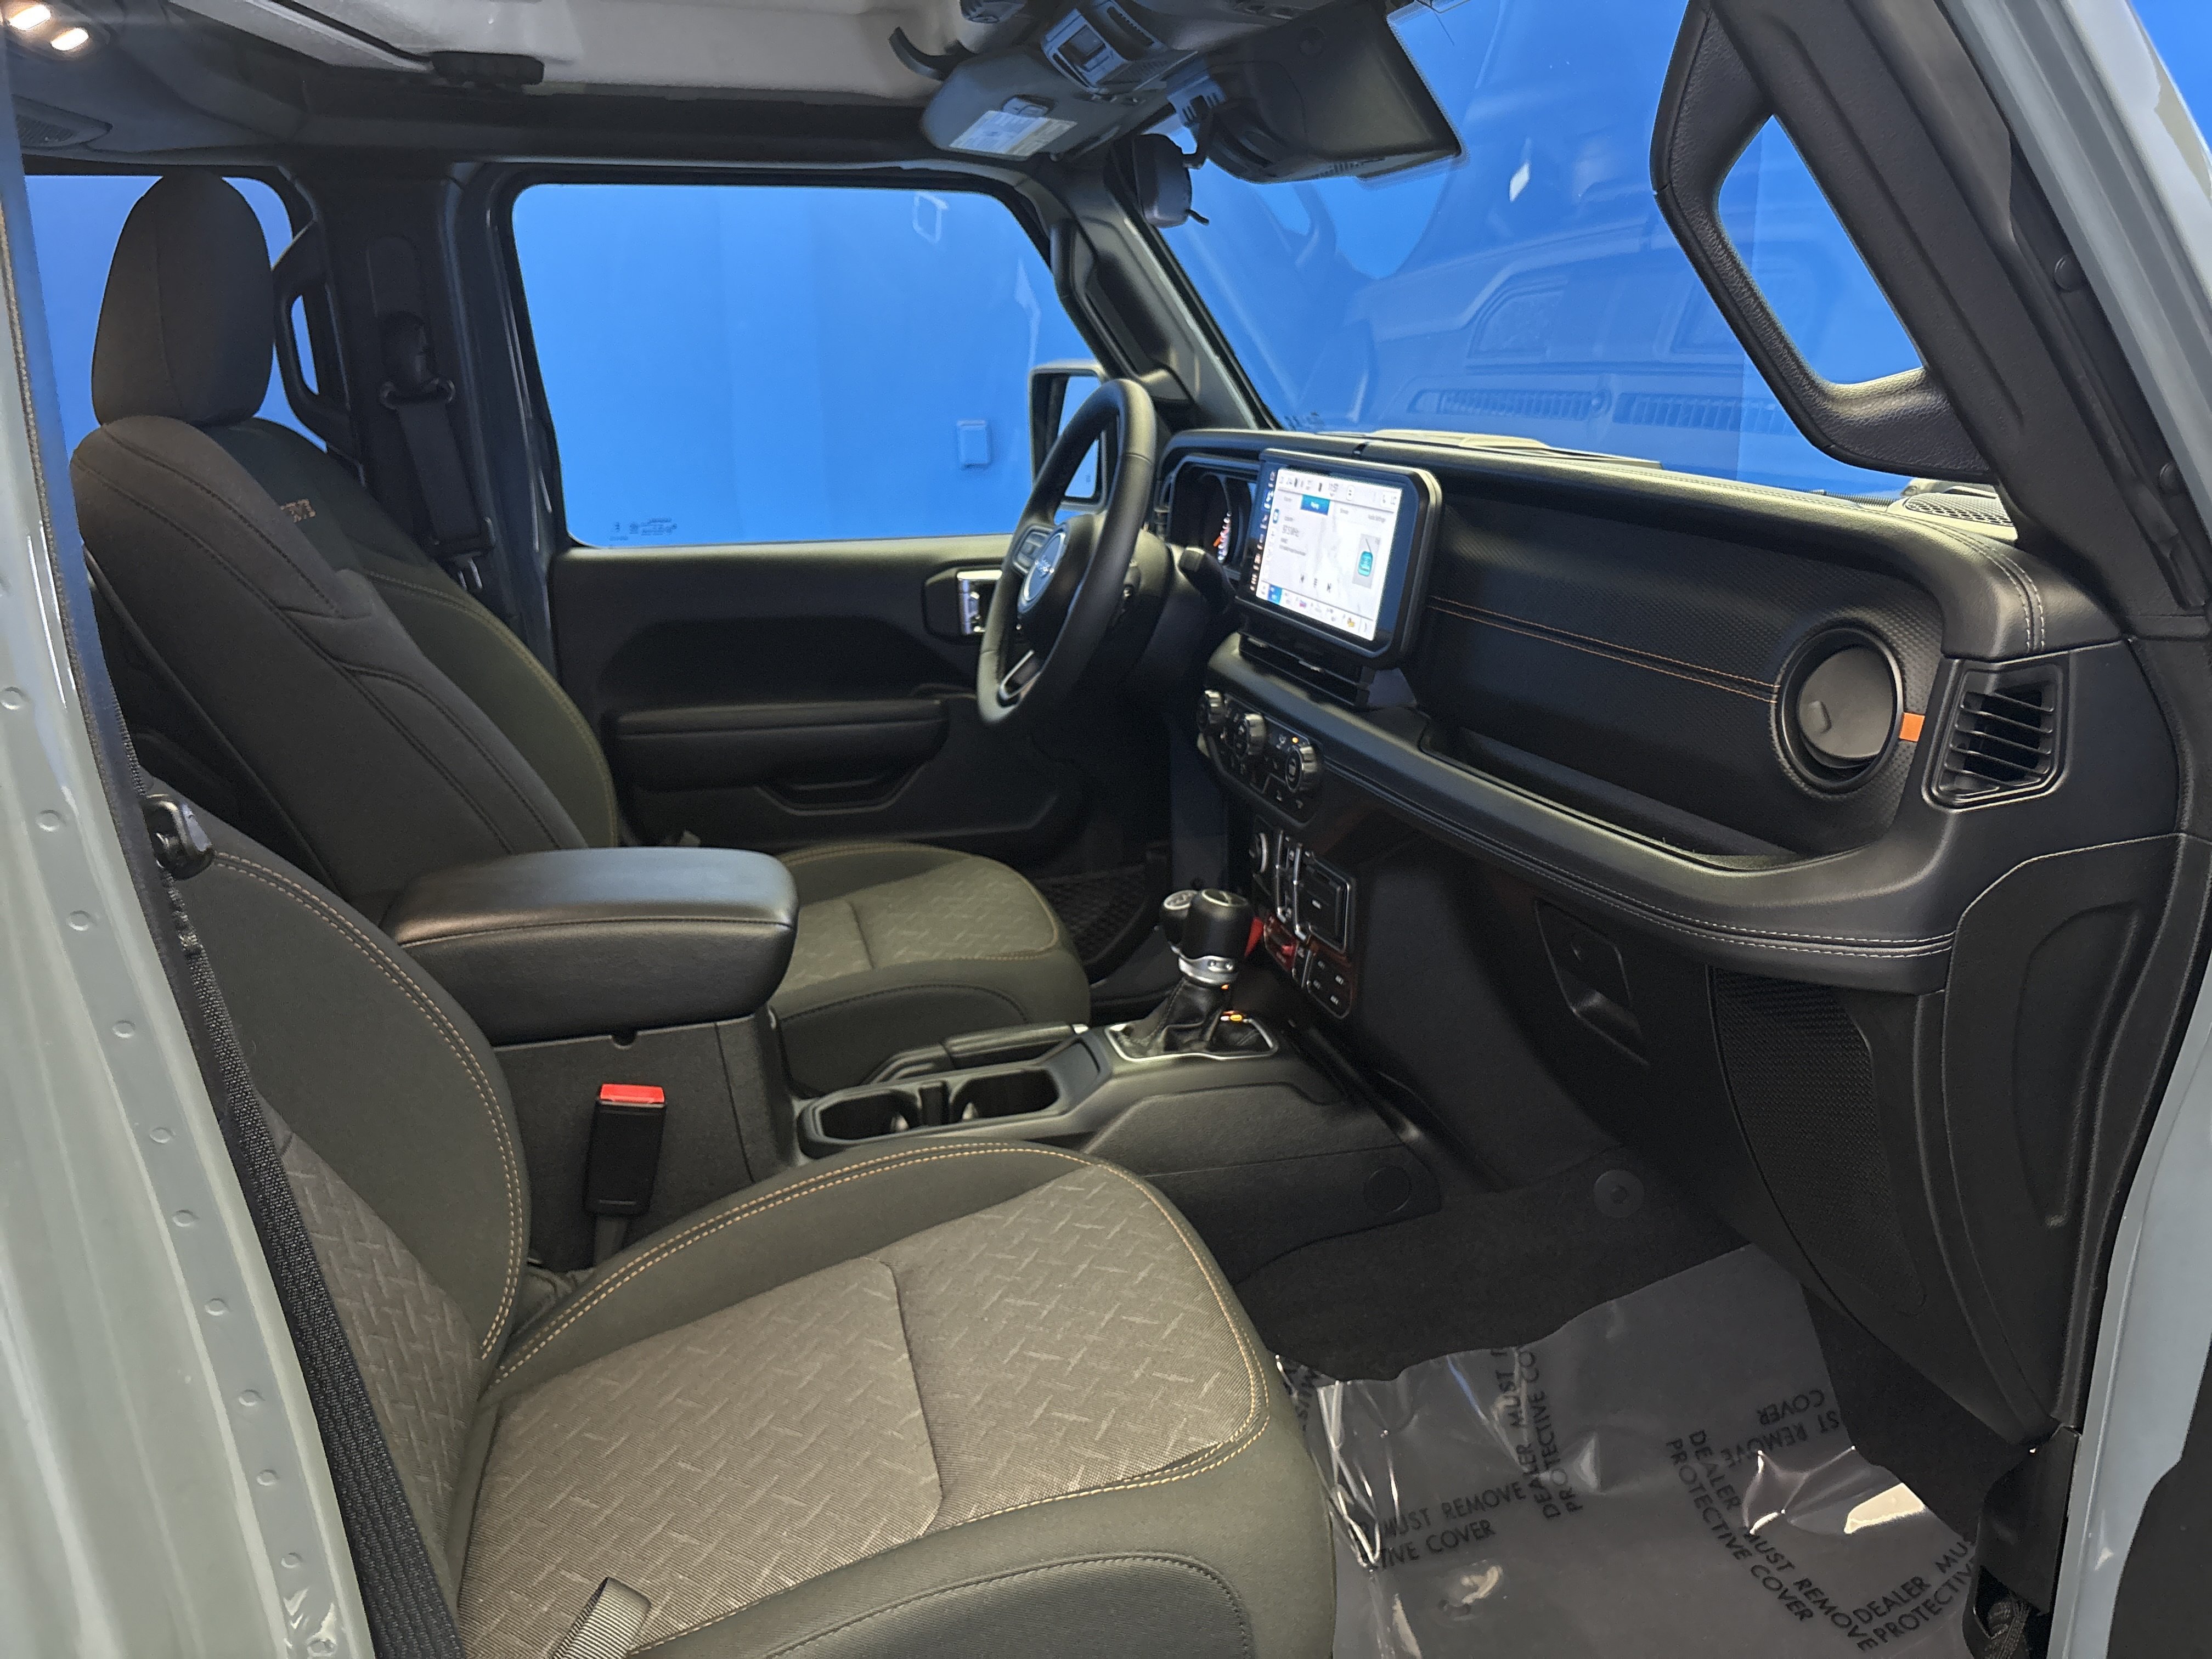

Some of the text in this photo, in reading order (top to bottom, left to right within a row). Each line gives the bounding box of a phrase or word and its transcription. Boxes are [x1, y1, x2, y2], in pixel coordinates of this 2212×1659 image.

[1757, 1389, 1825, 1425] COVER
[1721, 1422, 1808, 1468] REMOVE
[1441, 1481, 1526, 1519] REMOVE
[1426, 1519, 1496, 1554] COVER
[1666, 1438, 1814, 1622] PROTECTIVE COVER
[1689, 1429, 1742, 1510] DEALER
[1793, 1577, 1879, 1651] REMOVE
[1853, 1541, 1971, 1624] DEALER MU
